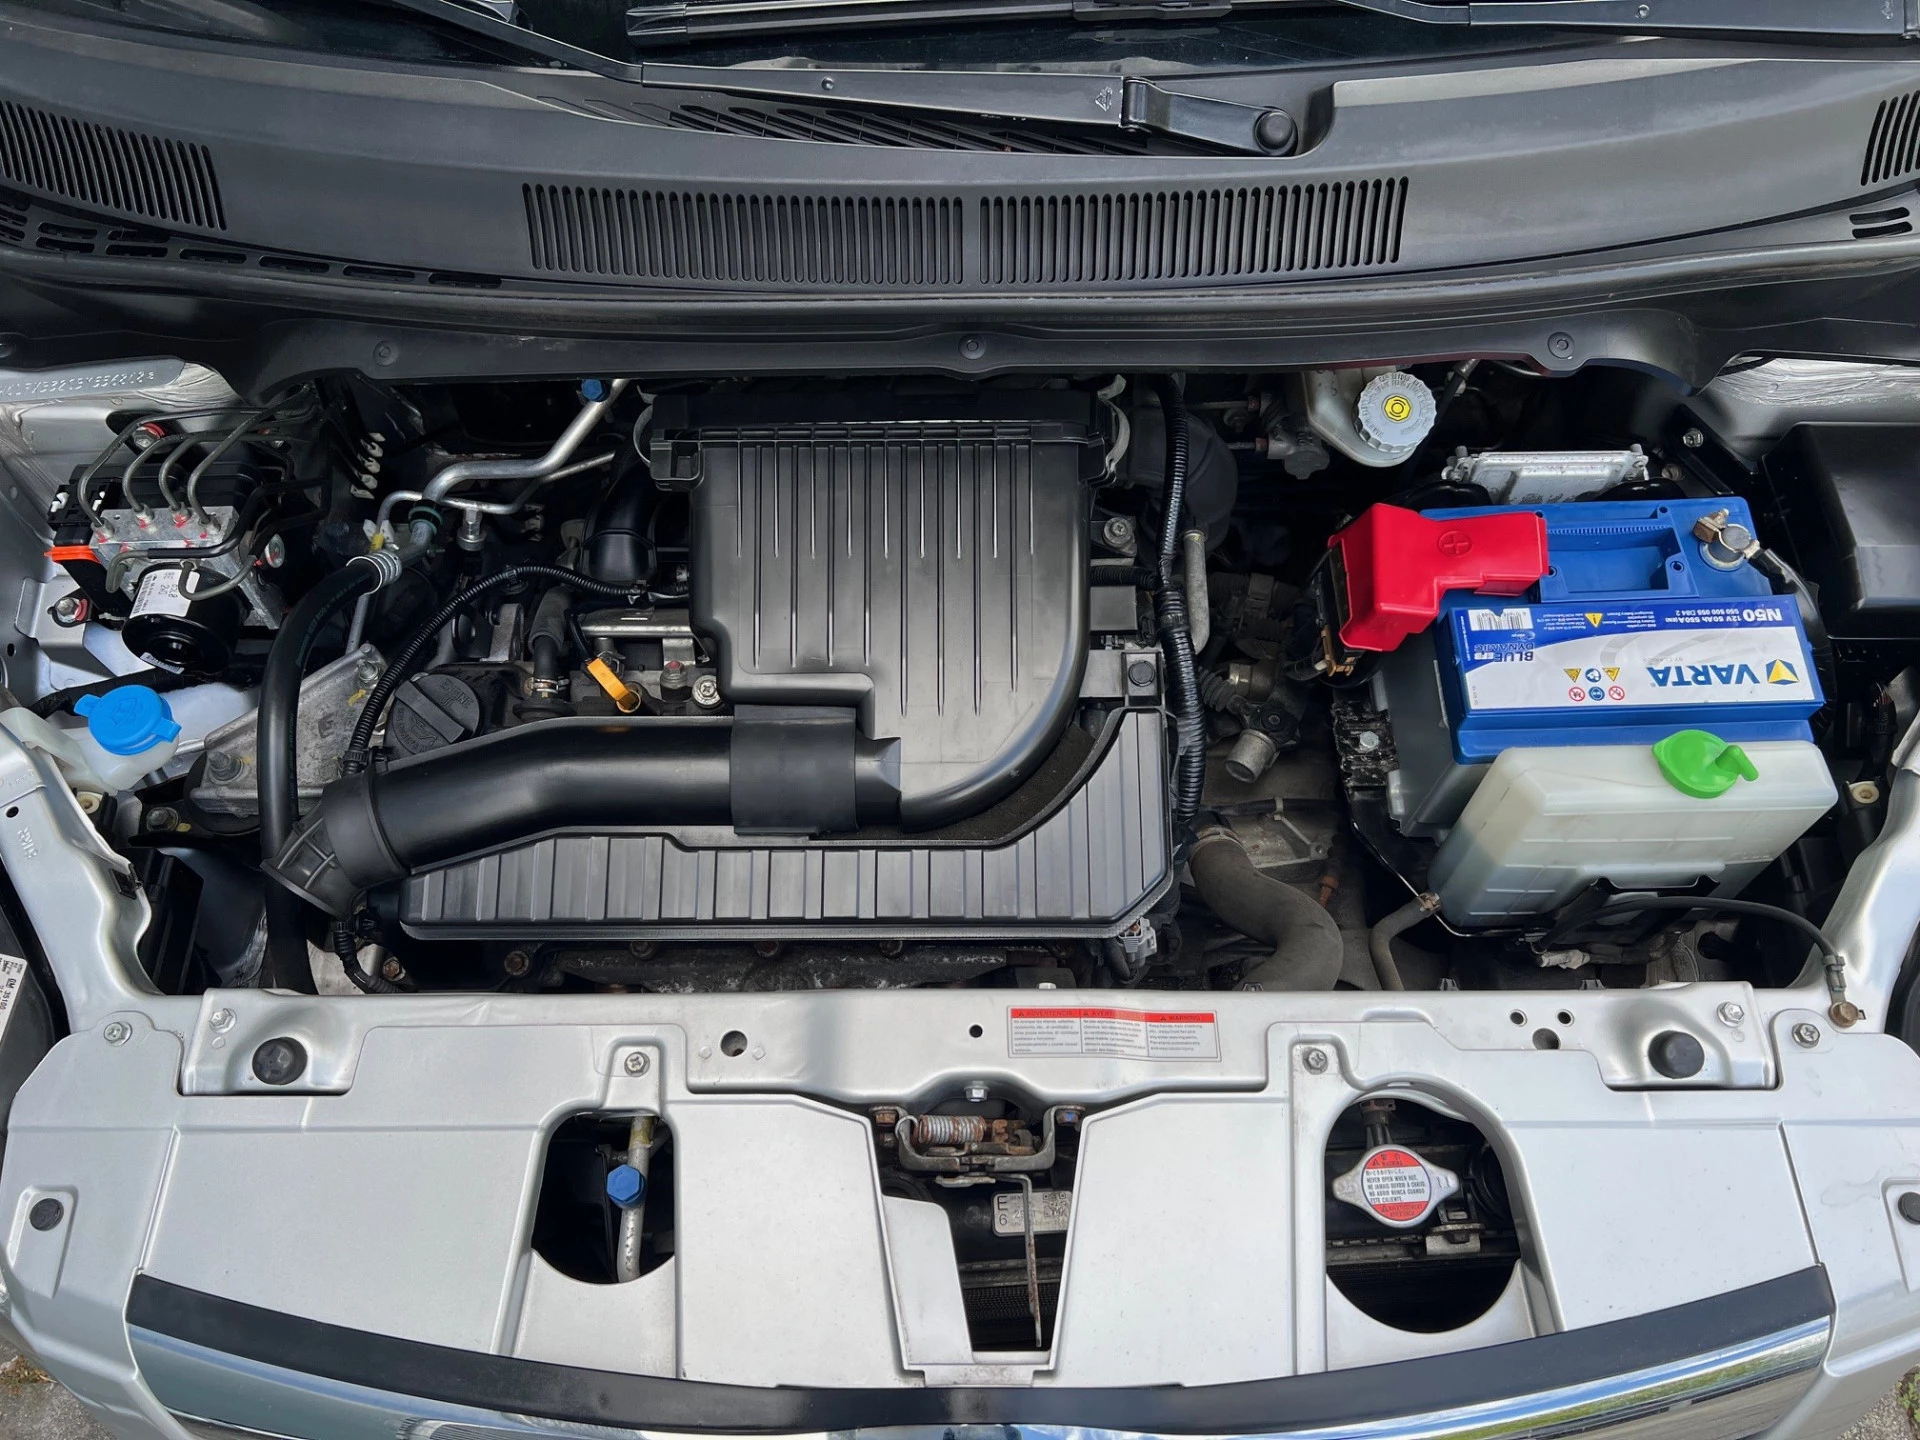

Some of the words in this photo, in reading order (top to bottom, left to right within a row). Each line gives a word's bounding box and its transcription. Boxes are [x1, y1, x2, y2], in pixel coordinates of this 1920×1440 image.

[1742, 608, 1783, 622] N50
[1474, 643, 1534, 652] DYNAMIC
[1494, 651, 1534, 662] BLUE
[1647, 664, 1761, 687] VARTA
[997, 1195, 1008, 1211] E
[999, 1213, 1008, 1226] 6
